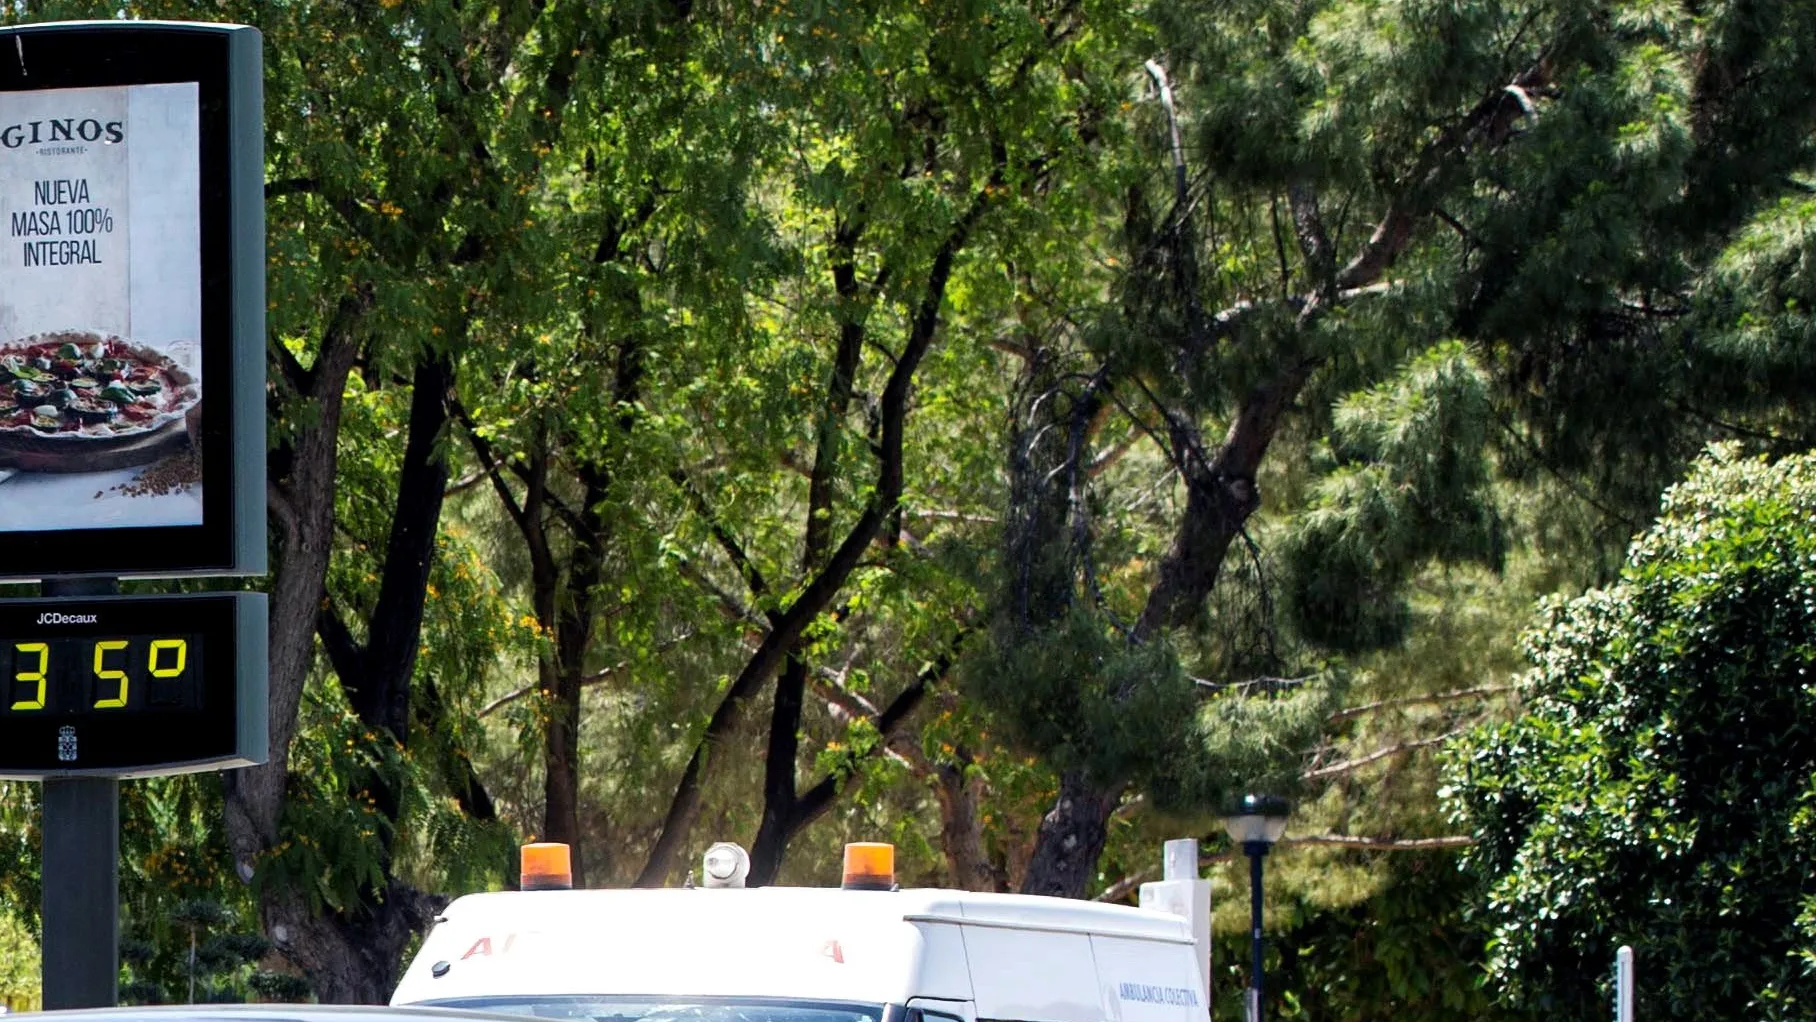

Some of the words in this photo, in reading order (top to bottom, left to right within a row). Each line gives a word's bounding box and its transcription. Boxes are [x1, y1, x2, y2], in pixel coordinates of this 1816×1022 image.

[0, 118, 124, 149] GINOS
[34, 178, 90, 206] NUEVA
[11, 210, 61, 237] MASA
[66, 208, 113, 235] 100%
[23, 238, 102, 267] INTEGRAL
[37, 612, 97, 625] JCDecaux
[1119, 982, 1164, 1004] AMBULANCIA
